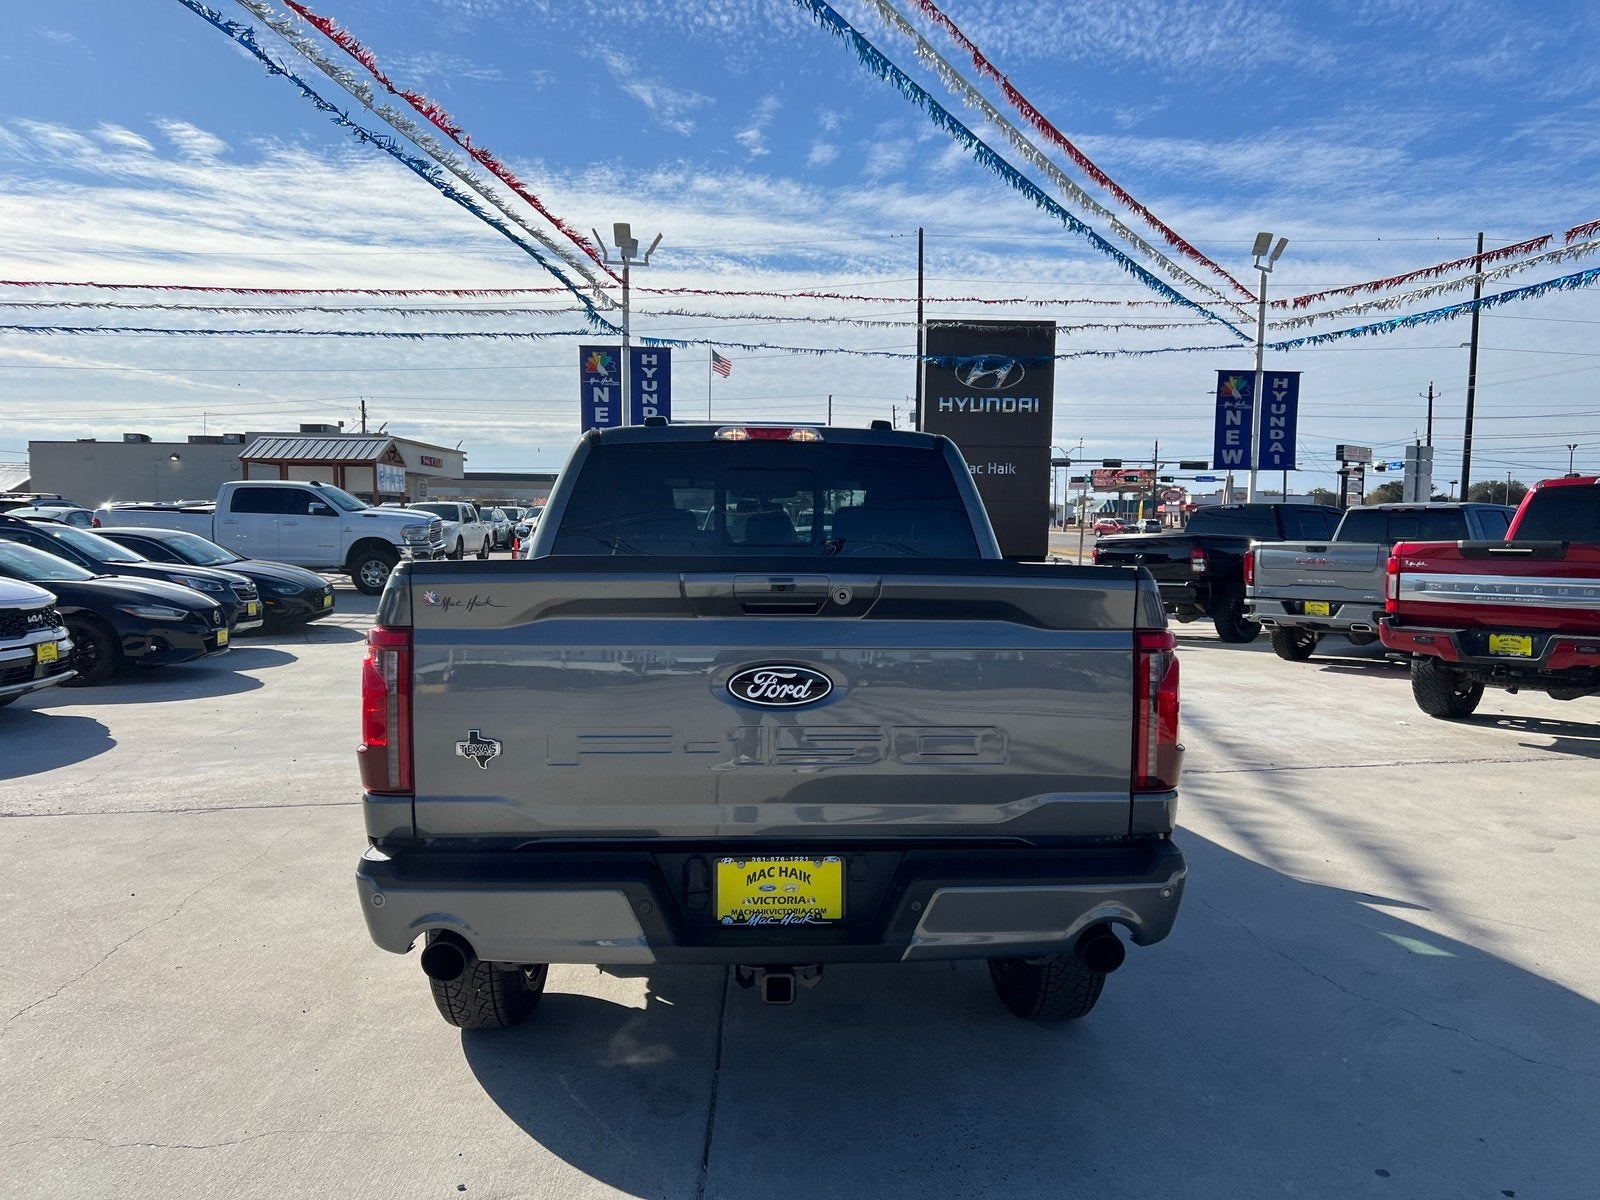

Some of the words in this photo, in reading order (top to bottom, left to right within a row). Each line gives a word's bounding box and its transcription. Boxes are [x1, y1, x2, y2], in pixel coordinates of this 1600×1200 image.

[641, 354, 658, 417] HYUND
[591, 387, 609, 430] NE
[938, 396, 1040, 413] HYUNDAI
[1269, 378, 1288, 464] HYUNDAI
[1221, 410, 1243, 464] NEW
[967, 462, 983, 475] ac
[988, 462, 1017, 475] Haik
[747, 671, 811, 699] Ford
[459, 744, 497, 754] TEXAS
[546, 725, 1009, 766] F-150
[746, 866, 776, 886] MAC
[778, 866, 811, 886] HAIK
[751, 896, 807, 905] VICTORIA
[731, 907, 827, 915] MACHAIKVICTORIA.COM
[746, 913, 779, 927] Mac
[780, 912, 819, 927] Haik
